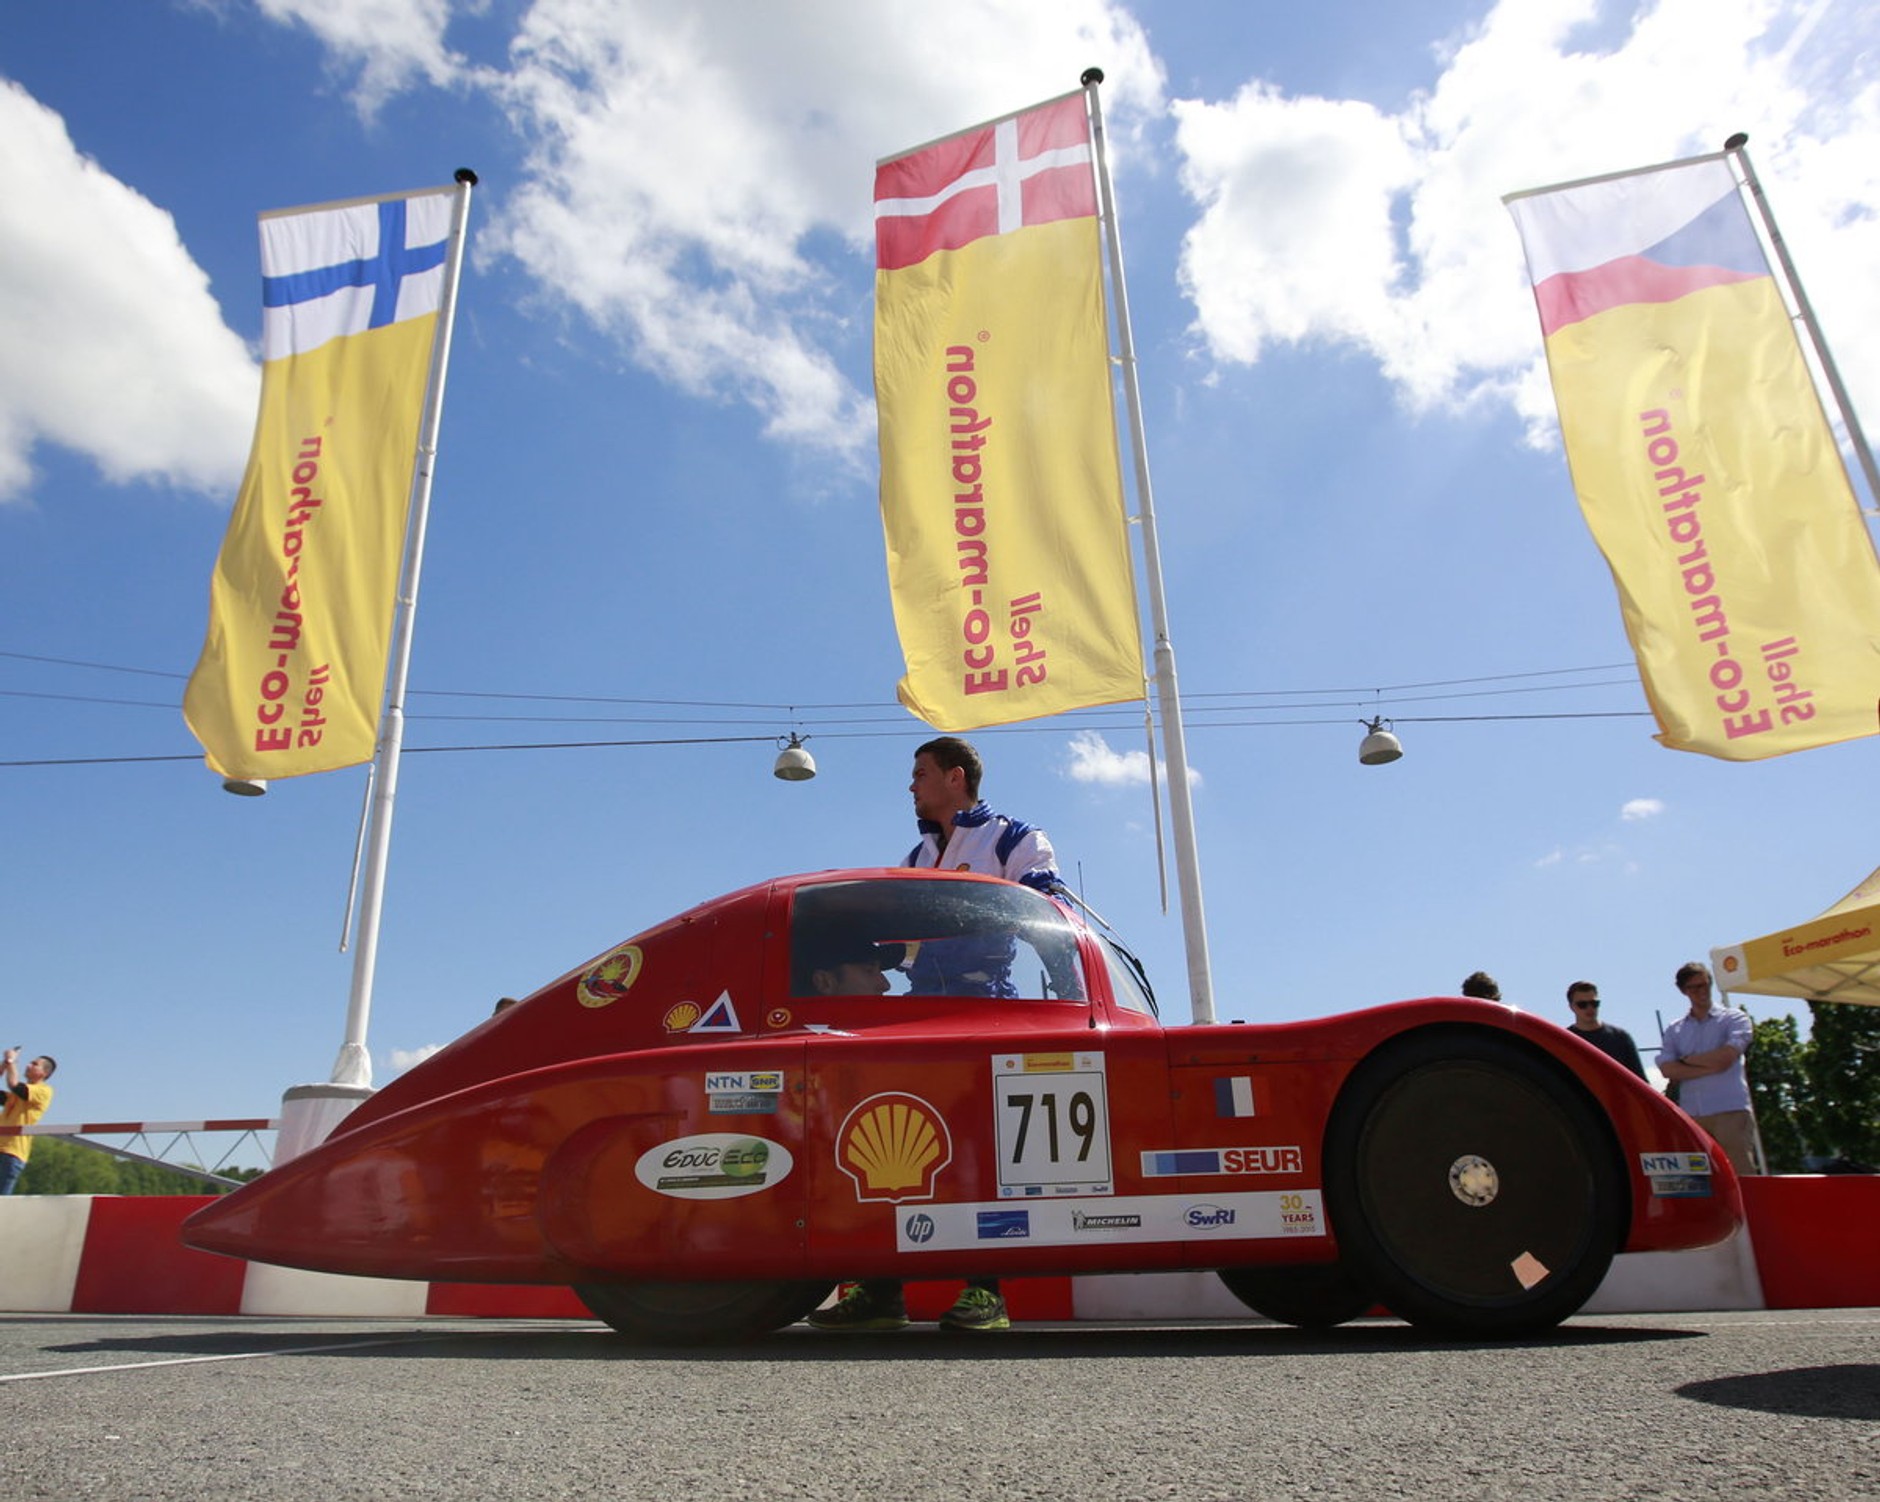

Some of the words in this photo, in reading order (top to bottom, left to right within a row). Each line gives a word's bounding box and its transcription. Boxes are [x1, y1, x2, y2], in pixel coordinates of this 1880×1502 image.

[707, 1076, 743, 1090] NTN
[751, 1077, 778, 1086] SNR
[1007, 1091, 1096, 1164] 719
[1224, 1150, 1302, 1172] SEUR
[1644, 1156, 1679, 1171] NTN
[1280, 1195, 1303, 1210] 30
[1087, 1215, 1139, 1226] MICHELIN
[1188, 1208, 1235, 1226] SwRI
[1282, 1213, 1315, 1224] YEARS
[909, 1215, 932, 1241] hp
